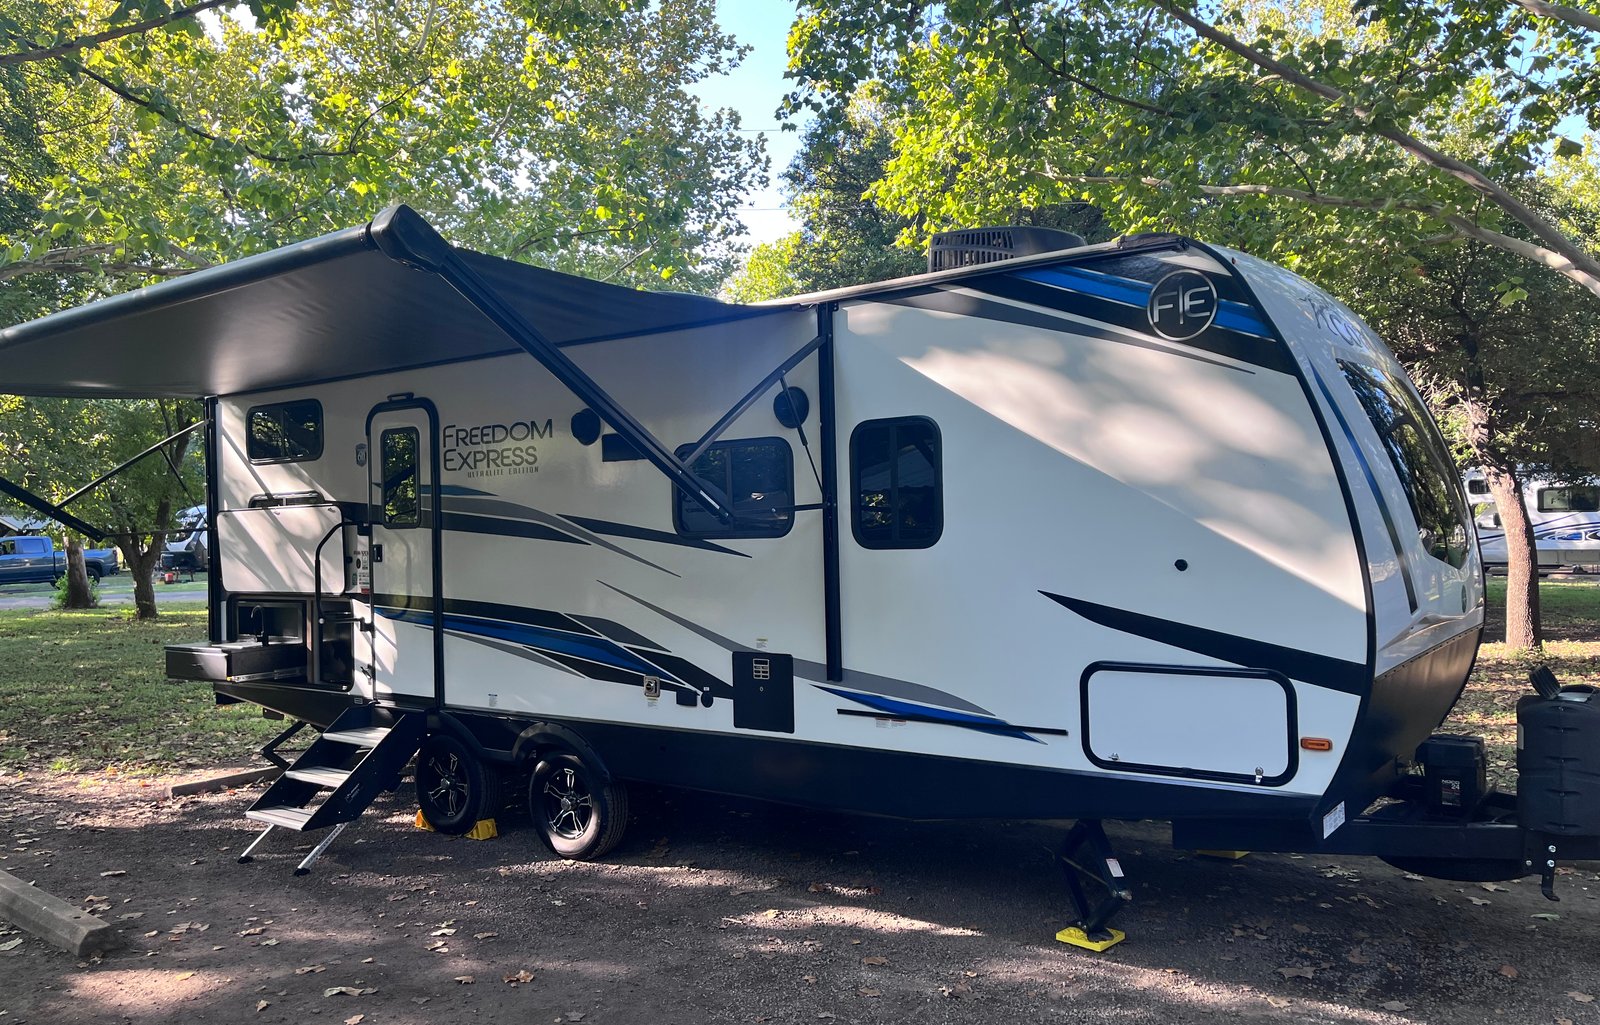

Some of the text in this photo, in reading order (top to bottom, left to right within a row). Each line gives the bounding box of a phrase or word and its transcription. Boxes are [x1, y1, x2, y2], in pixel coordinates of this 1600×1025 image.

[443, 419, 553, 448] FREEDOM
[443, 446, 538, 471] EXPRESS
[467, 466, 539, 478] ULTRALITE EDITION
